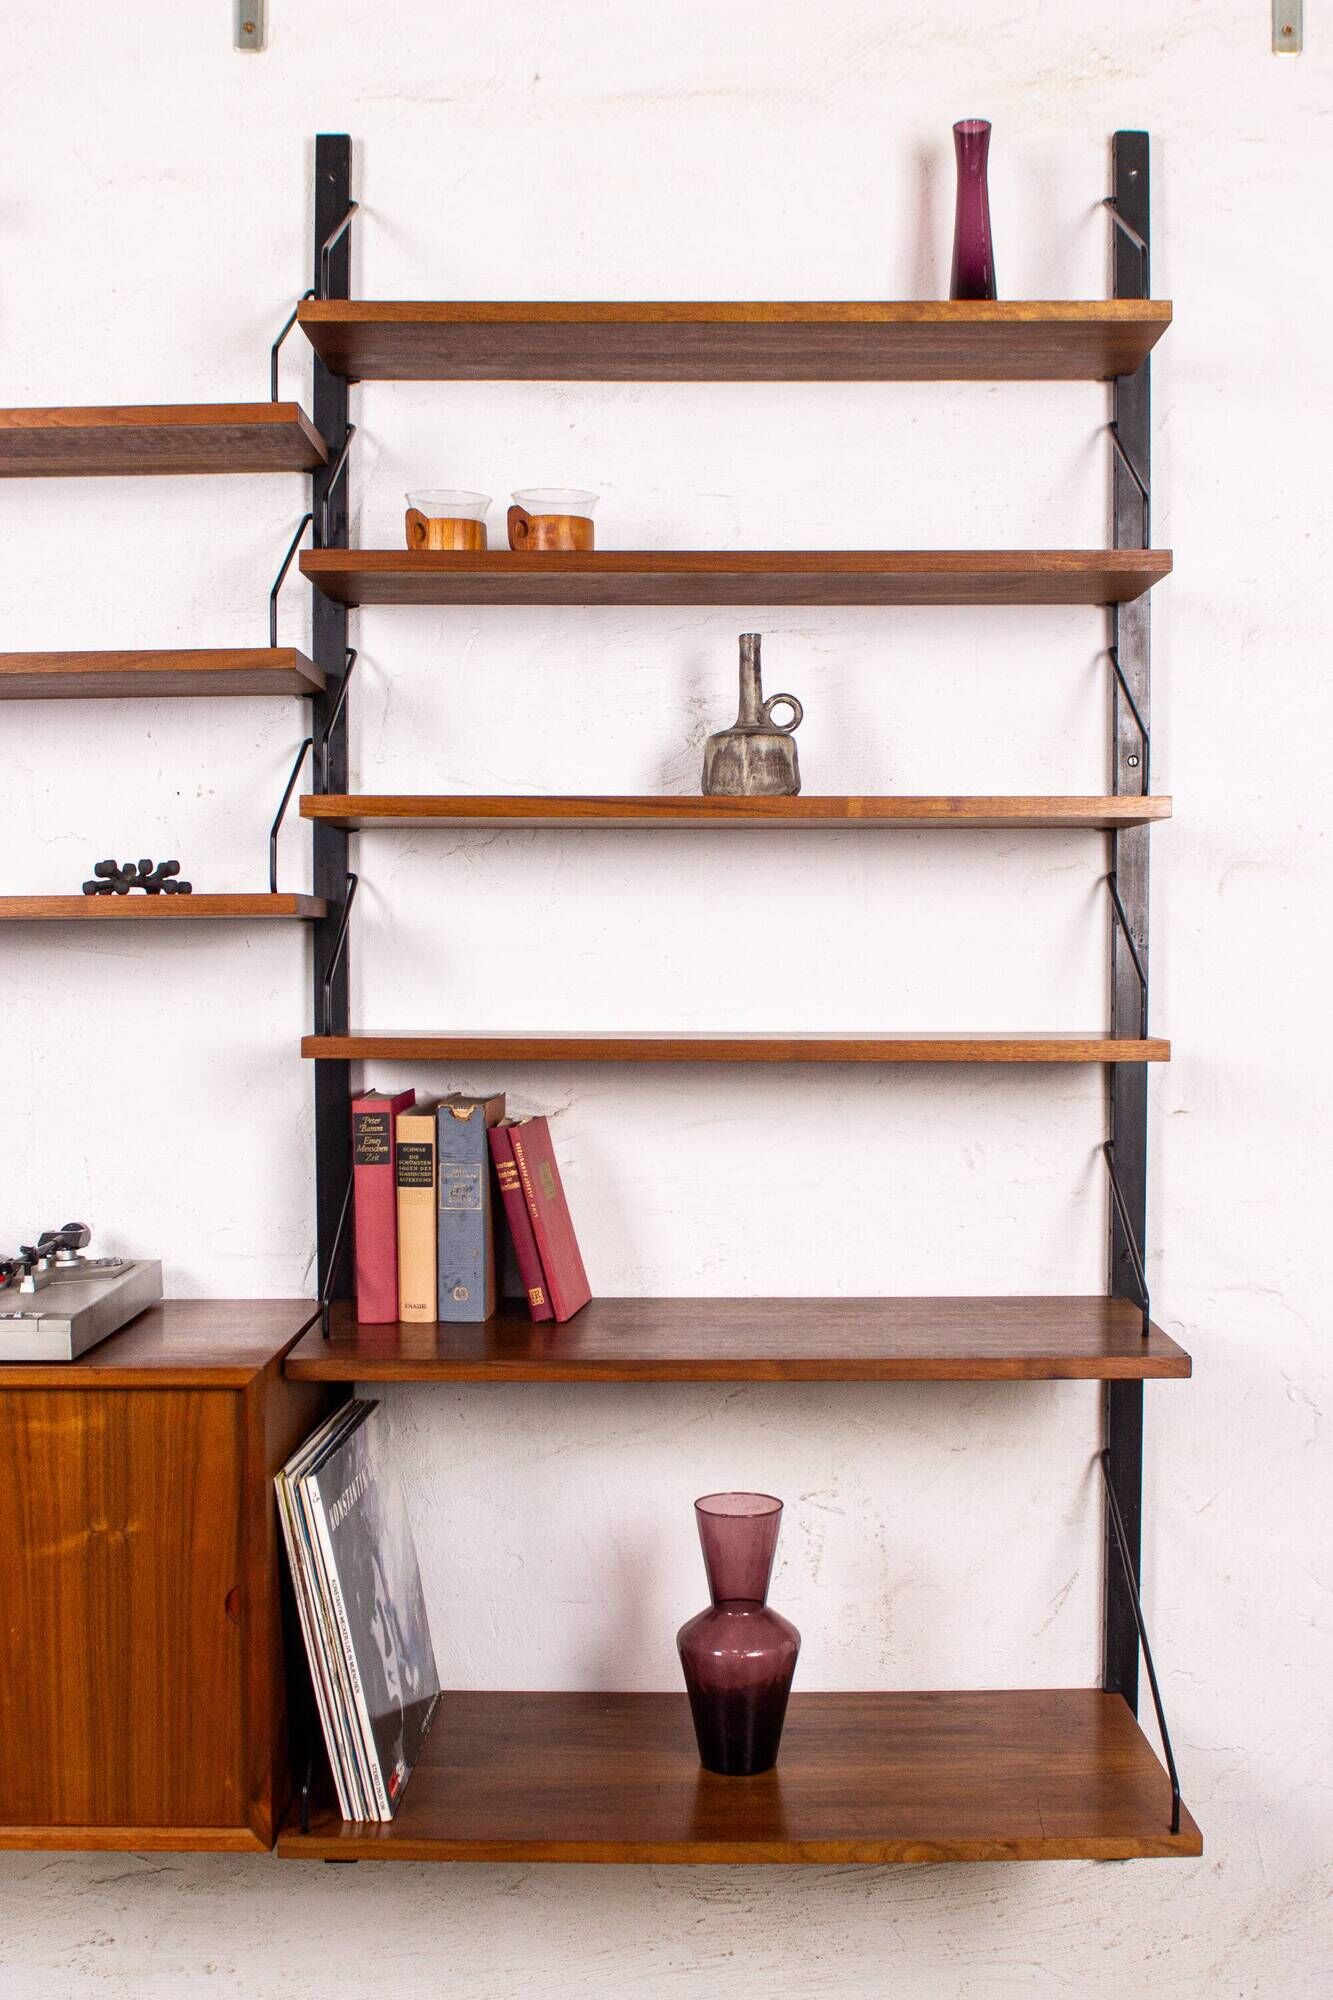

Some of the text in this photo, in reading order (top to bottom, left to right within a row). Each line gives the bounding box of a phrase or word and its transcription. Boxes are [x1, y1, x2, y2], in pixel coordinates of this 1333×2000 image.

[361, 1116, 382, 1125] Peter
[356, 1144, 389, 1153] Menschen
[365, 1153, 380, 1162] Zeit
[329, 1470, 368, 1531] KONSTANTIN
[332, 1579, 343, 1616] KONSTANTIN
